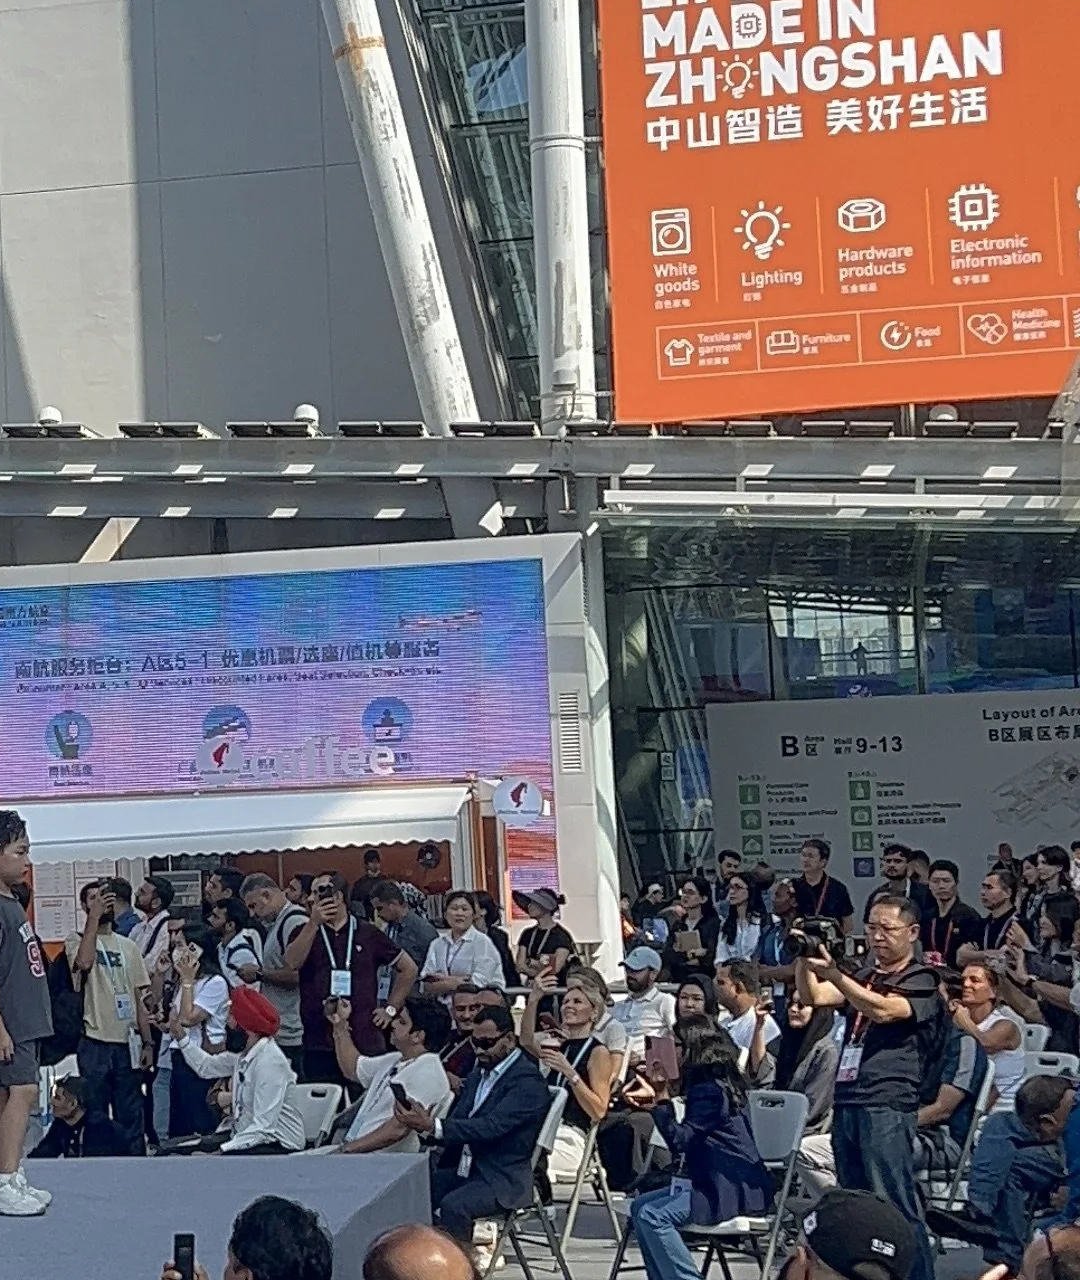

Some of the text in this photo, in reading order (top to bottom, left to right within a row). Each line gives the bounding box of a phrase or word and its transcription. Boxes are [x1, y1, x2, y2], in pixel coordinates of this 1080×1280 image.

[646, 85, 989, 152] 中山智造 美好生活
[838, 244, 914, 263] Hardware
[950, 234, 1029, 253] Electronic
[951, 250, 1042, 270] information
[653, 262, 698, 279] White
[741, 269, 803, 289] Lighting
[839, 261, 907, 282] products
[654, 277, 701, 297] goods
[802, 331, 851, 345] Furniture
[914, 325, 942, 338] Food
[982, 709, 1037, 722] Layout
[1040, 706, 1057, 718] of
[251, 734, 396, 776] coffee
[781, 735, 800, 757] B
[855, 736, 904, 754] 9-13
